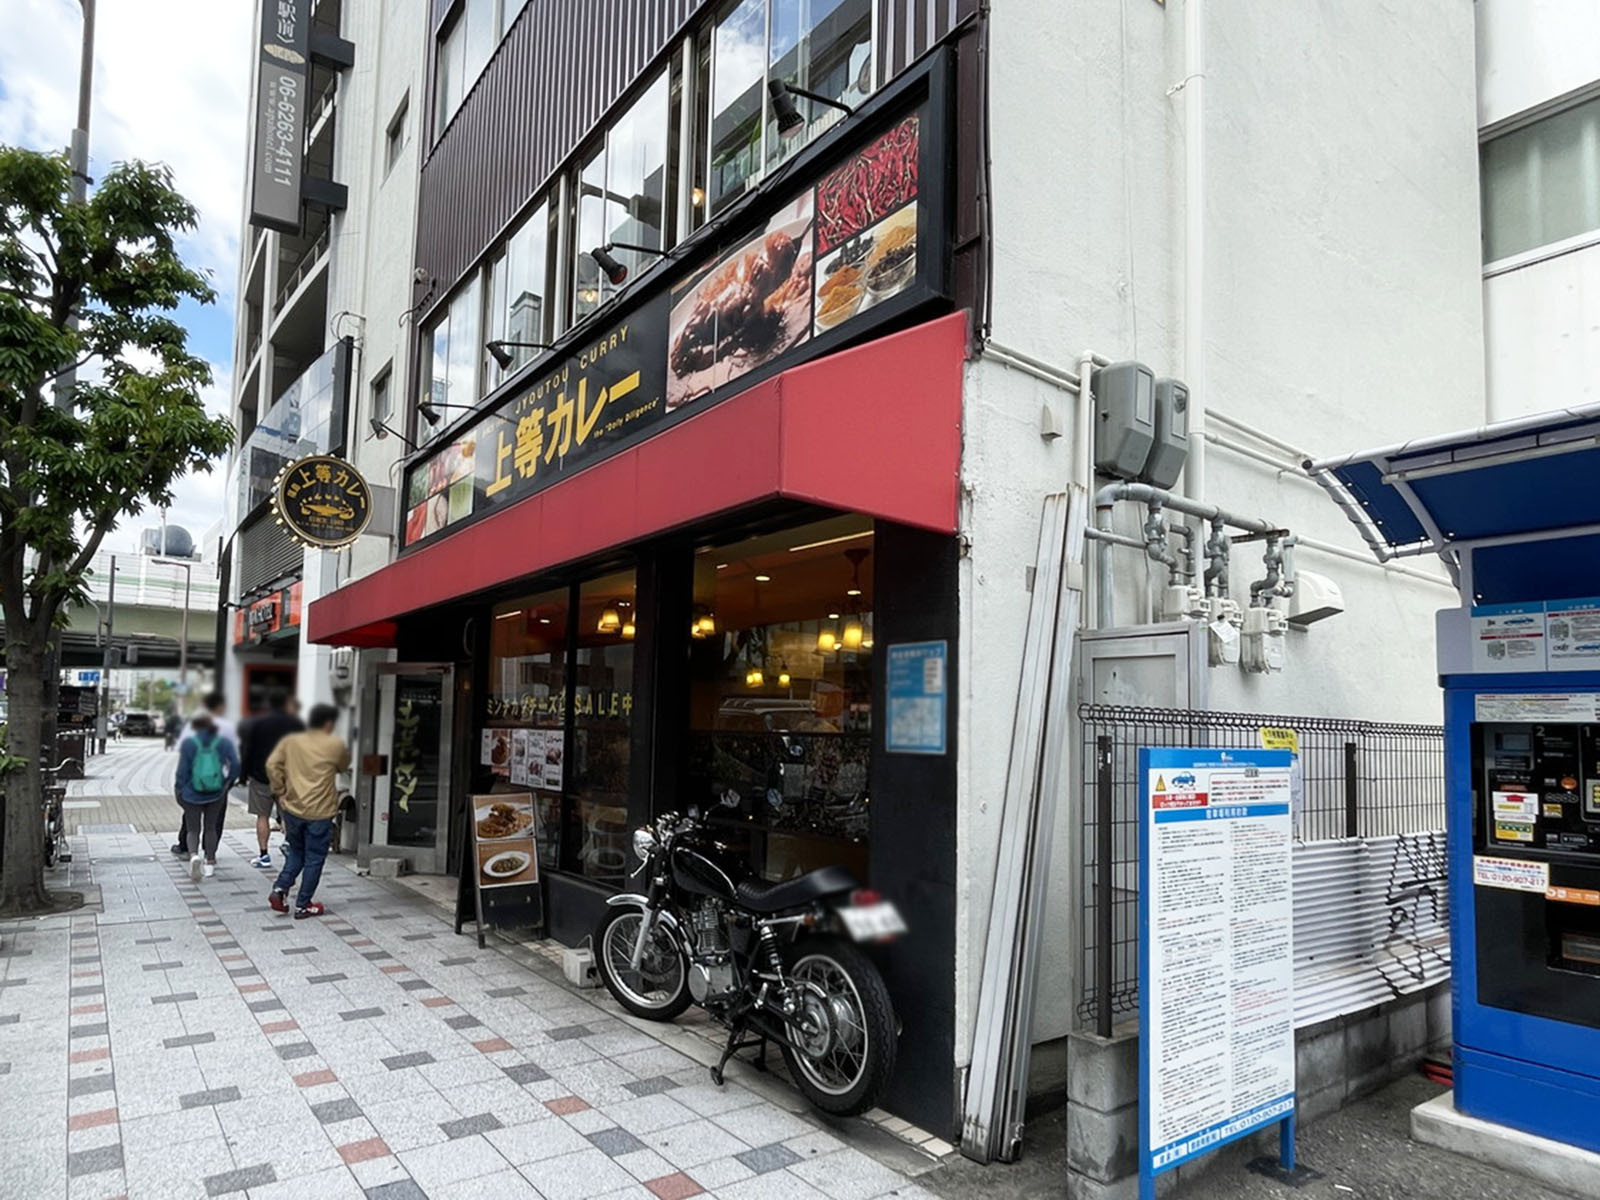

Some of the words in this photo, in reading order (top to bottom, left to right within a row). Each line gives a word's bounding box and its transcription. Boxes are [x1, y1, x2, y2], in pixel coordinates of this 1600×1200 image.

[273, 75, 297, 187] 06-6263-4111
[515, 368, 569, 414] JYOUTOU
[580, 325, 629, 369] CURRY
[485, 370, 641, 498] 上等カレー
[1535, 725, 1546, 737] 2
